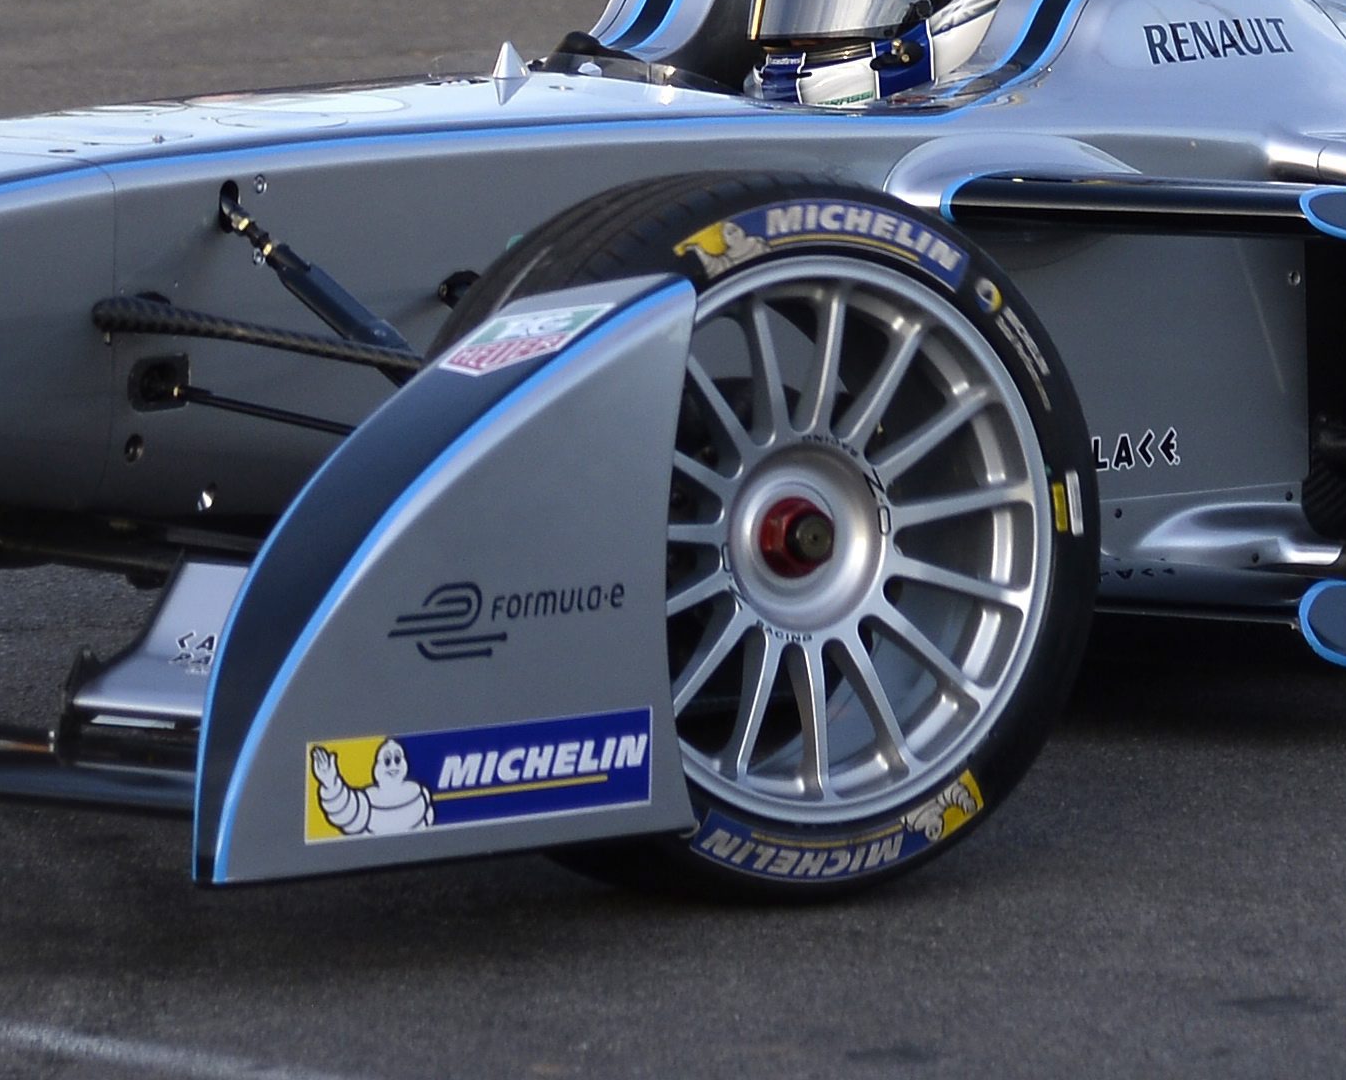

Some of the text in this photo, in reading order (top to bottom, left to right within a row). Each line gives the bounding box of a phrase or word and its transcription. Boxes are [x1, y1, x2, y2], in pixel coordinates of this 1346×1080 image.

[1143, 18, 1294, 65] RENAULT
[765, 203, 962, 272] MICHELIN
[437, 734, 648, 789] MICHELIN
[703, 826, 905, 877] MICHELIN
